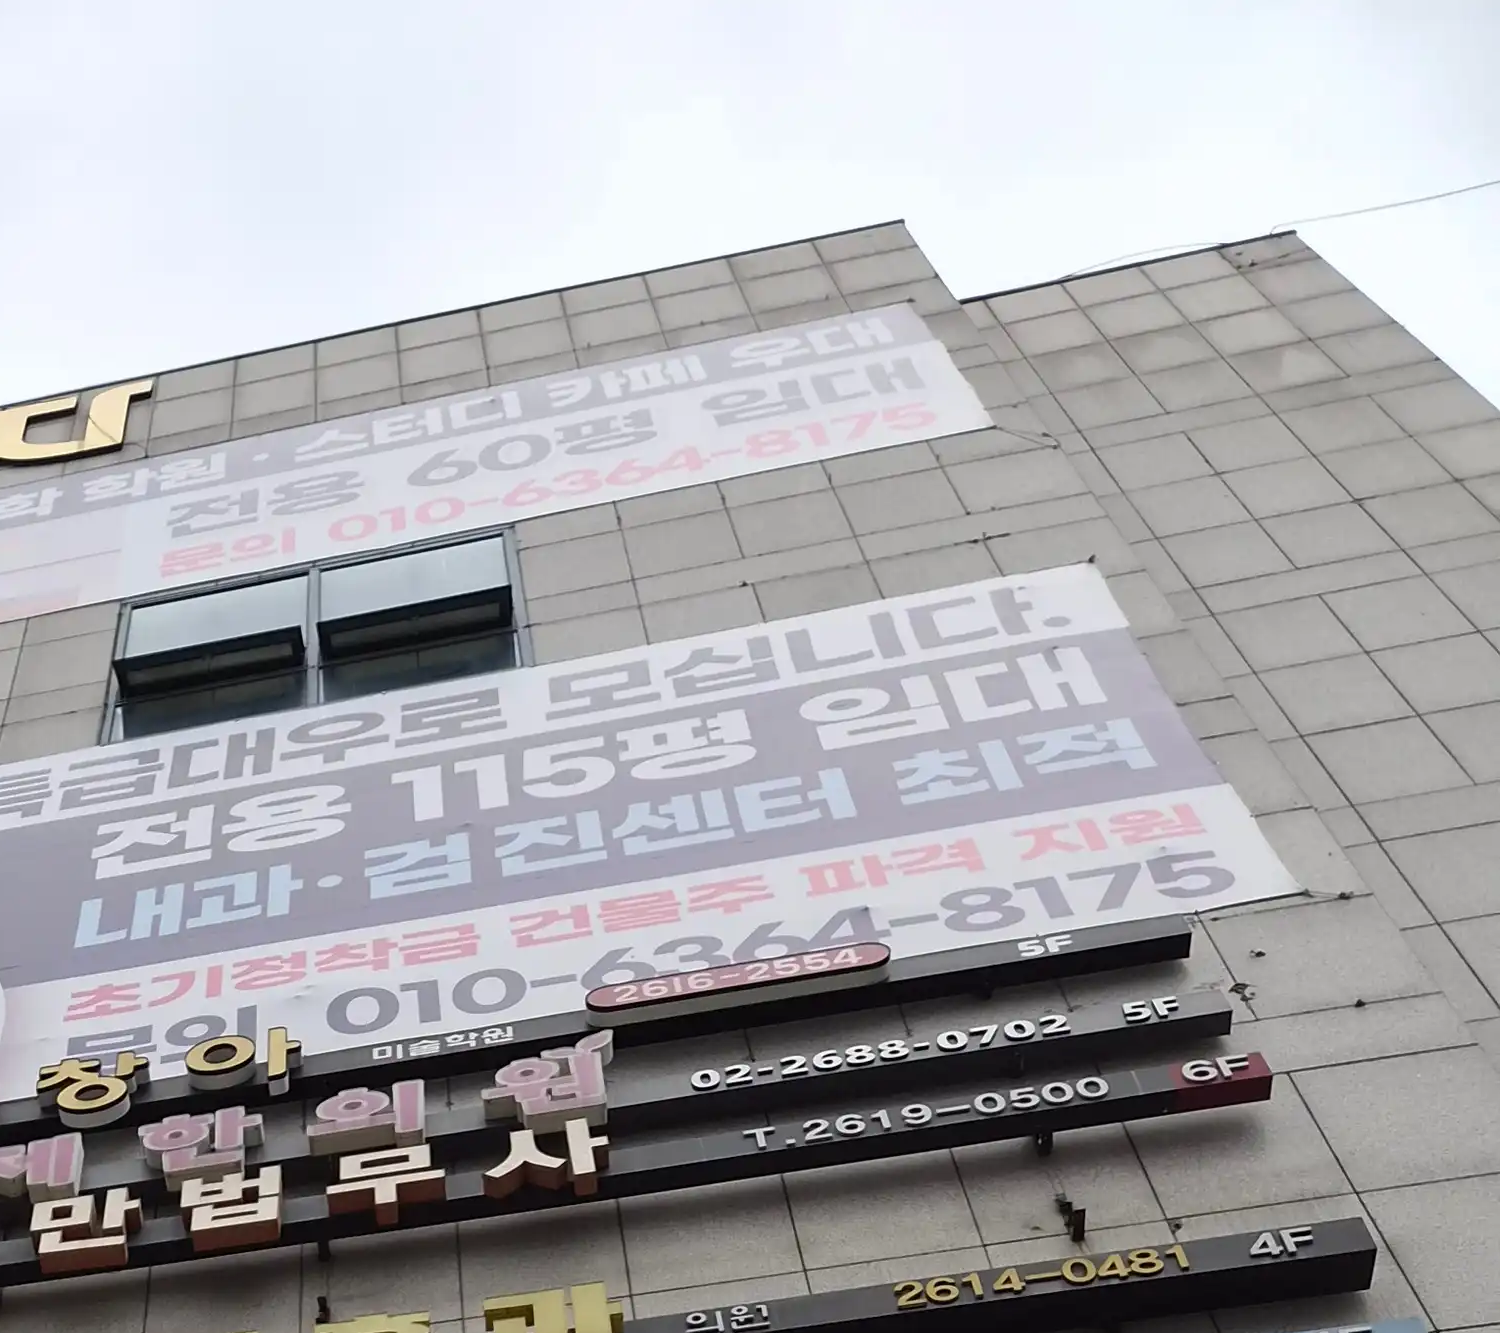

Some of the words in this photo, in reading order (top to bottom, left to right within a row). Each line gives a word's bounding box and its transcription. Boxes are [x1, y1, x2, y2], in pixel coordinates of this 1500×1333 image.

[83, 452, 227, 503] 학원
[295, 390, 523, 456] 스터디
[547, 351, 705, 410] 카페
[729, 317, 895, 373] 우대
[163, 470, 368, 539] 전용
[406, 408, 658, 488] 60평
[701, 357, 926, 427] 임대
[160, 527, 295, 577] 문의
[328, 402, 937, 544] 010-6364-8175
[548, 587, 1072, 720] 모십니다.
[91, 784, 351, 880] 전용
[391, 710, 757, 823] 115평
[799, 646, 1108, 750] 임대
[896, 718, 1158, 805] 최적
[62, 923, 481, 1022] 초기정착금
[508, 874, 776, 948] 건물주
[799, 836, 987, 897] 파격
[1011, 803, 1206, 861] 지원
[372, 1024, 516, 1060] 미술학원
[613, 948, 863, 1004] 2616-2554
[1017, 933, 1073, 959] 5F
[689, 1014, 1072, 1092] 02-2688-0702
[1121, 995, 1180, 1025] 5F
[1179, 1053, 1254, 1086] 6F
[894, 1243, 1194, 1311] 2614-0481
[1249, 1225, 1315, 1260] 4F
